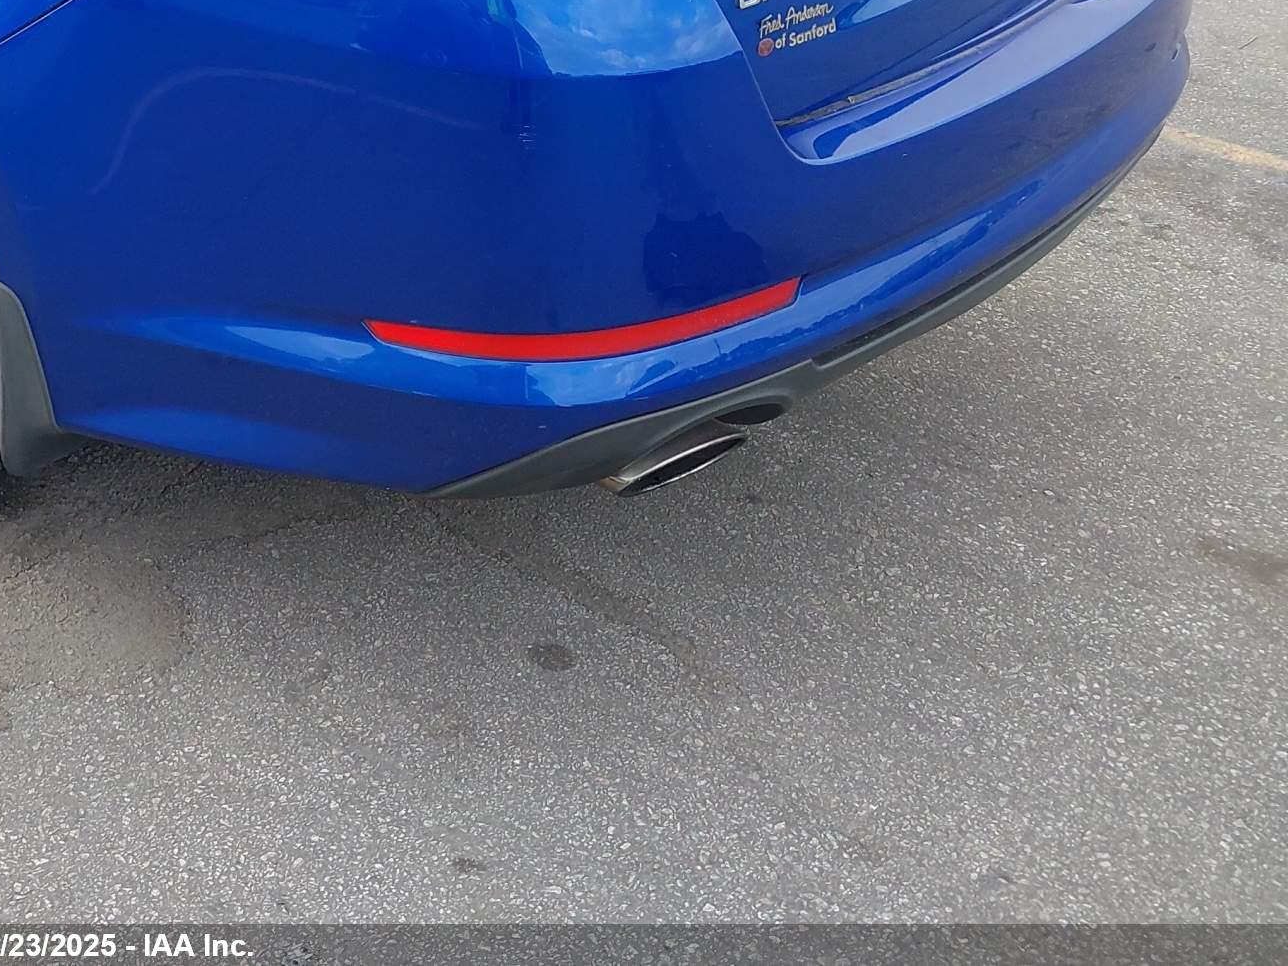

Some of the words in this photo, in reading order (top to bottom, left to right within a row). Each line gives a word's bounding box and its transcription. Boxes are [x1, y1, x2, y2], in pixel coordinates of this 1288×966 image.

[758, 14, 785, 39] Fred
[774, 33, 787, 50] of
[788, 17, 838, 48] Sanford
